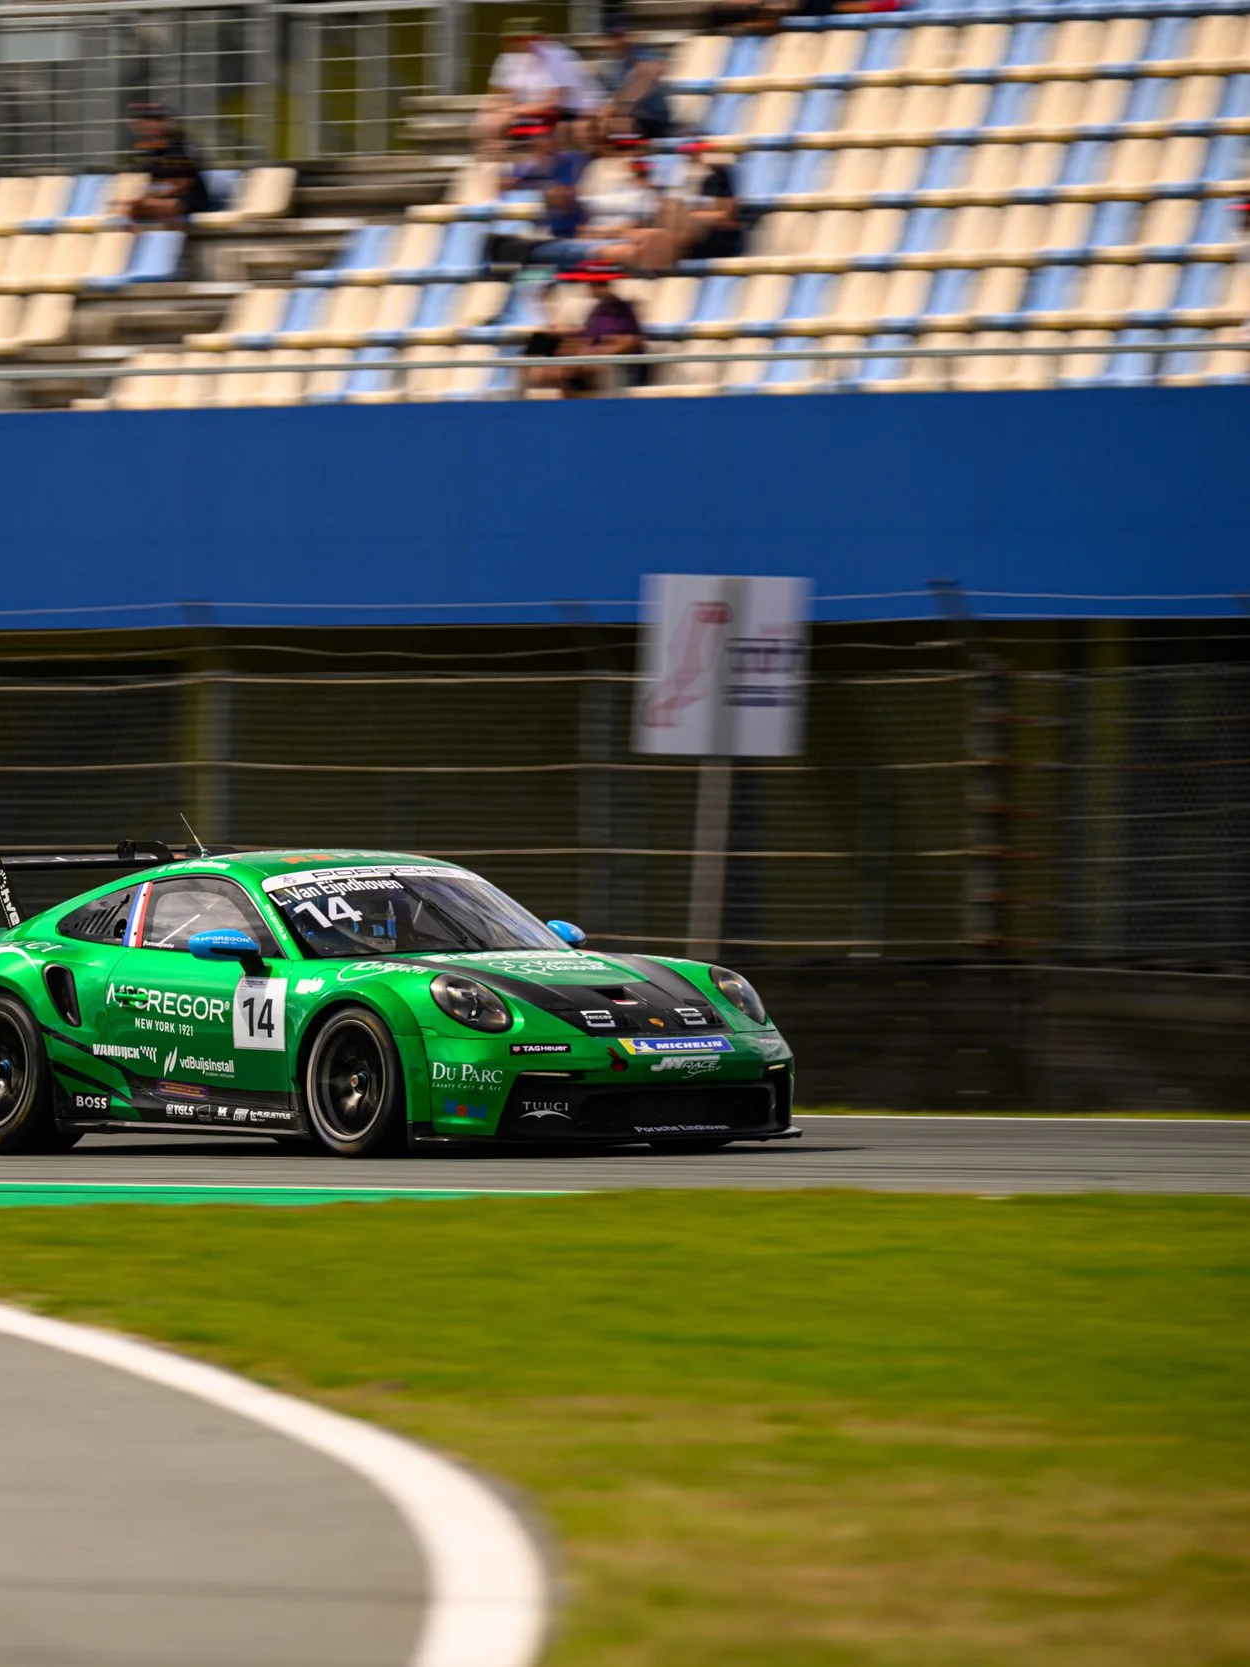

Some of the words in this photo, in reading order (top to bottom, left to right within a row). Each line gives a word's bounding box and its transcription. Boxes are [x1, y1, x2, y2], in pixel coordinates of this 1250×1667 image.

[312, 867, 454, 879] PORSCHE
[268, 892, 291, 907] L.
[289, 886, 320, 901] Van
[293, 896, 363, 929] 14
[242, 997, 275, 1038] 14
[135, 1017, 154, 1030] NEW
[154, 1020, 175, 1034] YORK
[179, 1024, 194, 1036] 1921
[656, 1040, 723, 1050] MICHELIN
[76, 1095, 107, 1109] BOSS
[444, 1098, 487, 1118] Mobil
[522, 1101, 568, 1111] TUUCI
[173, 1104, 194, 1116] TGLS
[634, 1125, 679, 1133] Porsche
